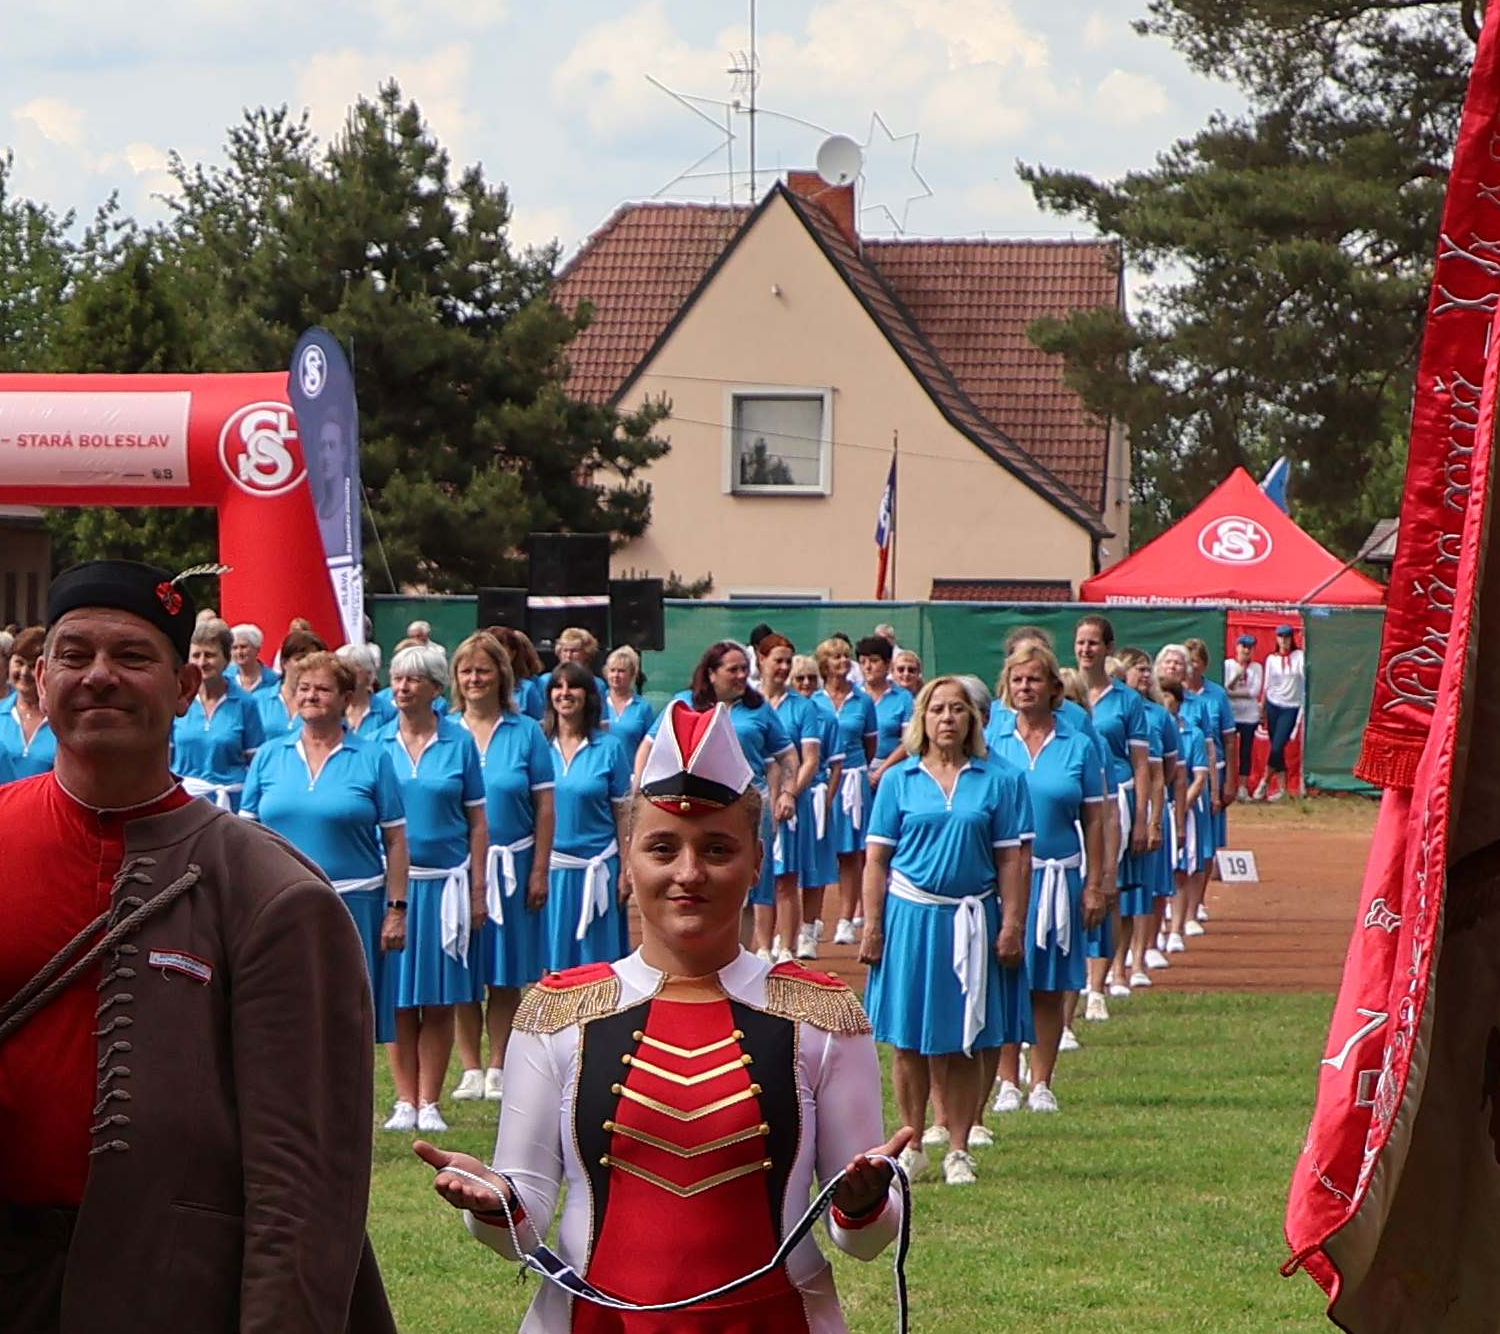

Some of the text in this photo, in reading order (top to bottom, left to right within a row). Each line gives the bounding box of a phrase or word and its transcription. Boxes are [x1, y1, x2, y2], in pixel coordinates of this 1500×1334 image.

[17, 430, 73, 448] STARÁ
[79, 434, 170, 448] BOLESLAV
[1227, 857, 1247, 875] 19
